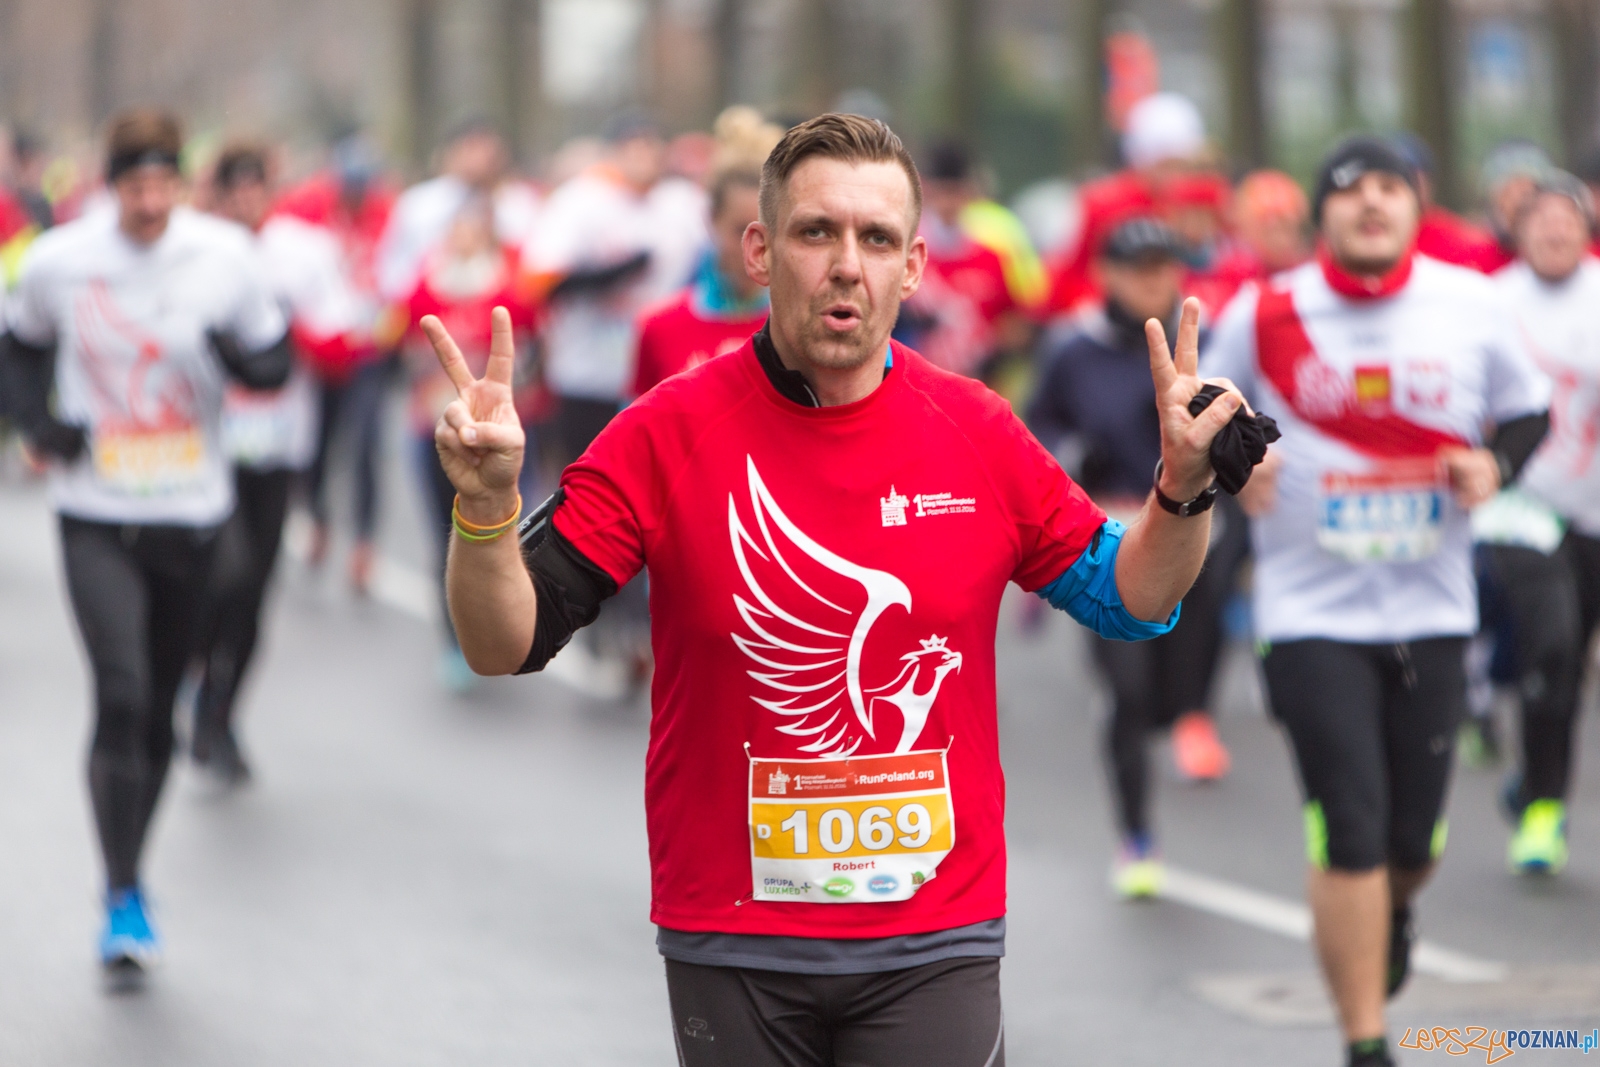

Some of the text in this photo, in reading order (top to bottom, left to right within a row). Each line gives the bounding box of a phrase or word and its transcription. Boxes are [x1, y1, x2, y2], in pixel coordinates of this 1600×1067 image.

[913, 494, 926, 517] 1
[757, 803, 932, 854] D 1069
[833, 860, 876, 871] Robert
[763, 878, 795, 887] GRUPA
[764, 886, 801, 895] LUXMED
